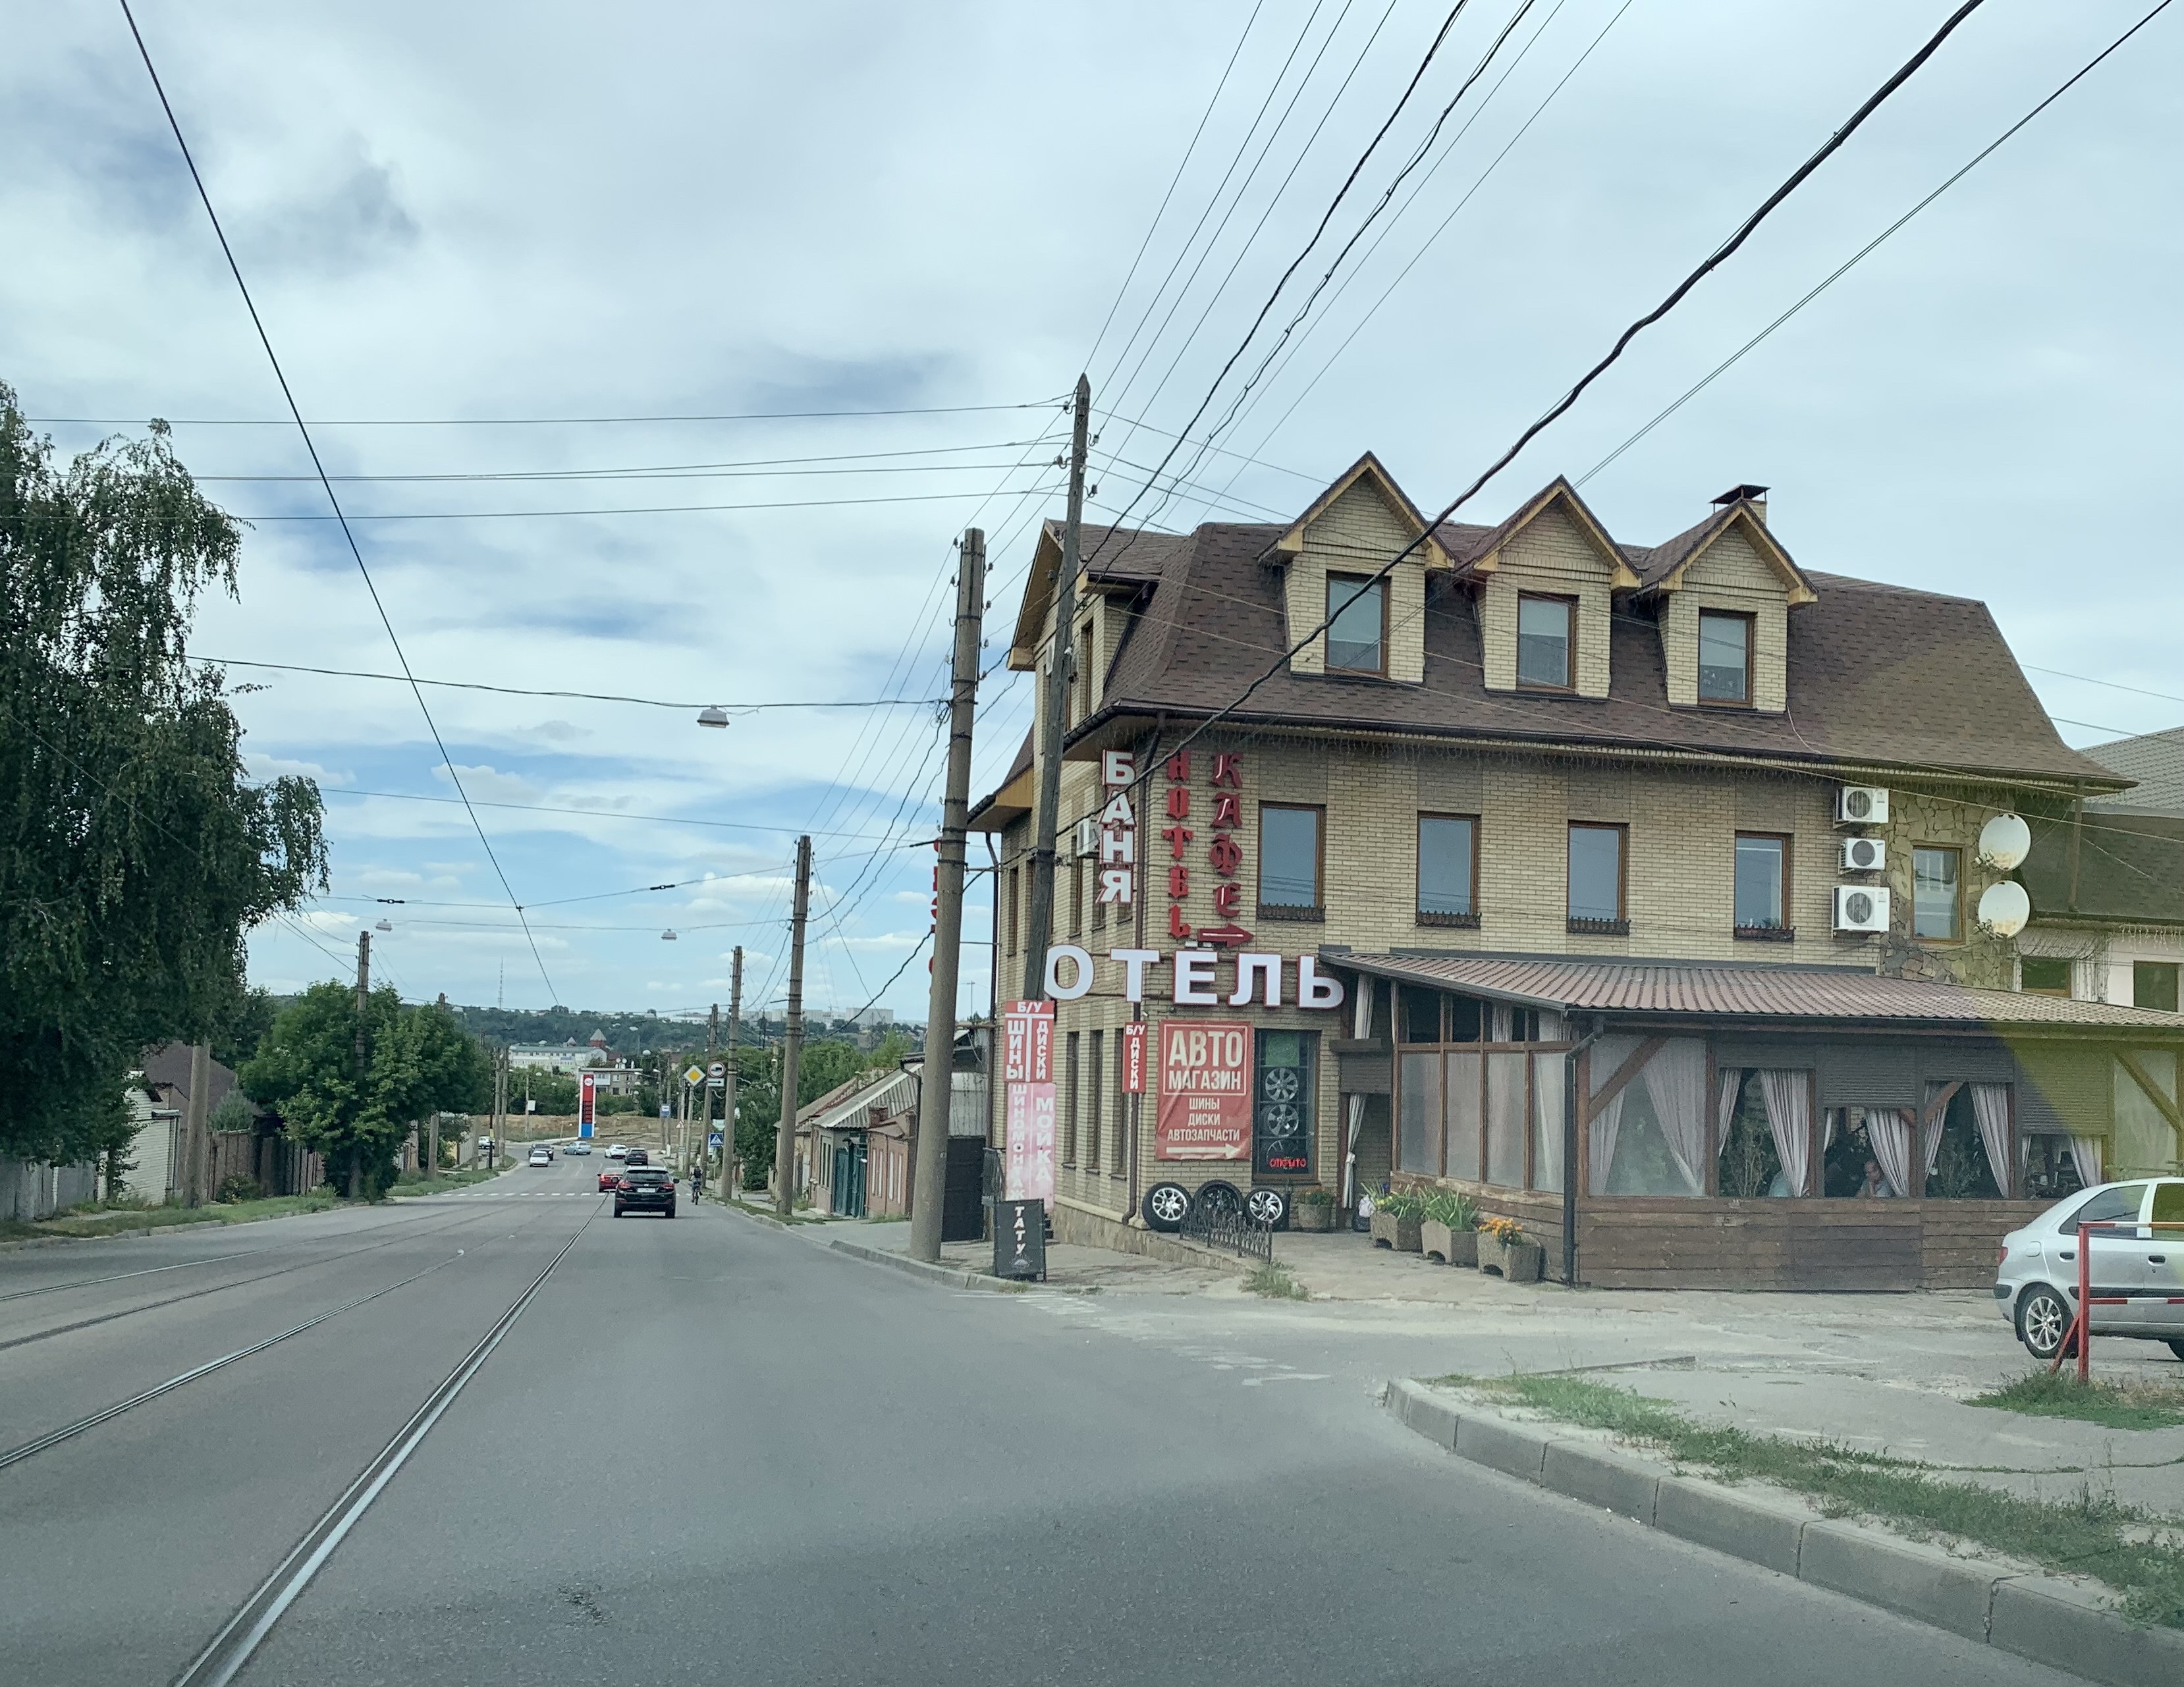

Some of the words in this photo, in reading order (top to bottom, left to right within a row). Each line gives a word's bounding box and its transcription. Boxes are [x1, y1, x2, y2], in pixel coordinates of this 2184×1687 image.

[1095, 749, 1137, 904] БАНЯ
[1208, 752, 1243, 918] КАФЕ
[1043, 944, 1345, 1009] ОТЕЛЬ
[1017, 1002, 1043, 1013] Б/У
[1126, 1025, 1145, 1036] Б/У
[1006, 1020, 1025, 1079] ШИНЫ
[1036, 1021, 1049, 1079] ДИСКИ
[1130, 1037, 1140, 1090] ДИСКИ
[1168, 1030, 1243, 1067] АВТО
[1168, 1070, 1242, 1090] МАГАЗИН
[1189, 1098, 1220, 1110] ШИНЫ
[1035, 1097, 1054, 1181] МОЙКА
[1167, 1129, 1240, 1141] АВТОЗАПЧАСТИ
[1188, 1113, 1220, 1127] ДИСКИ
[1013, 1206, 1026, 1254] ТАТУ
